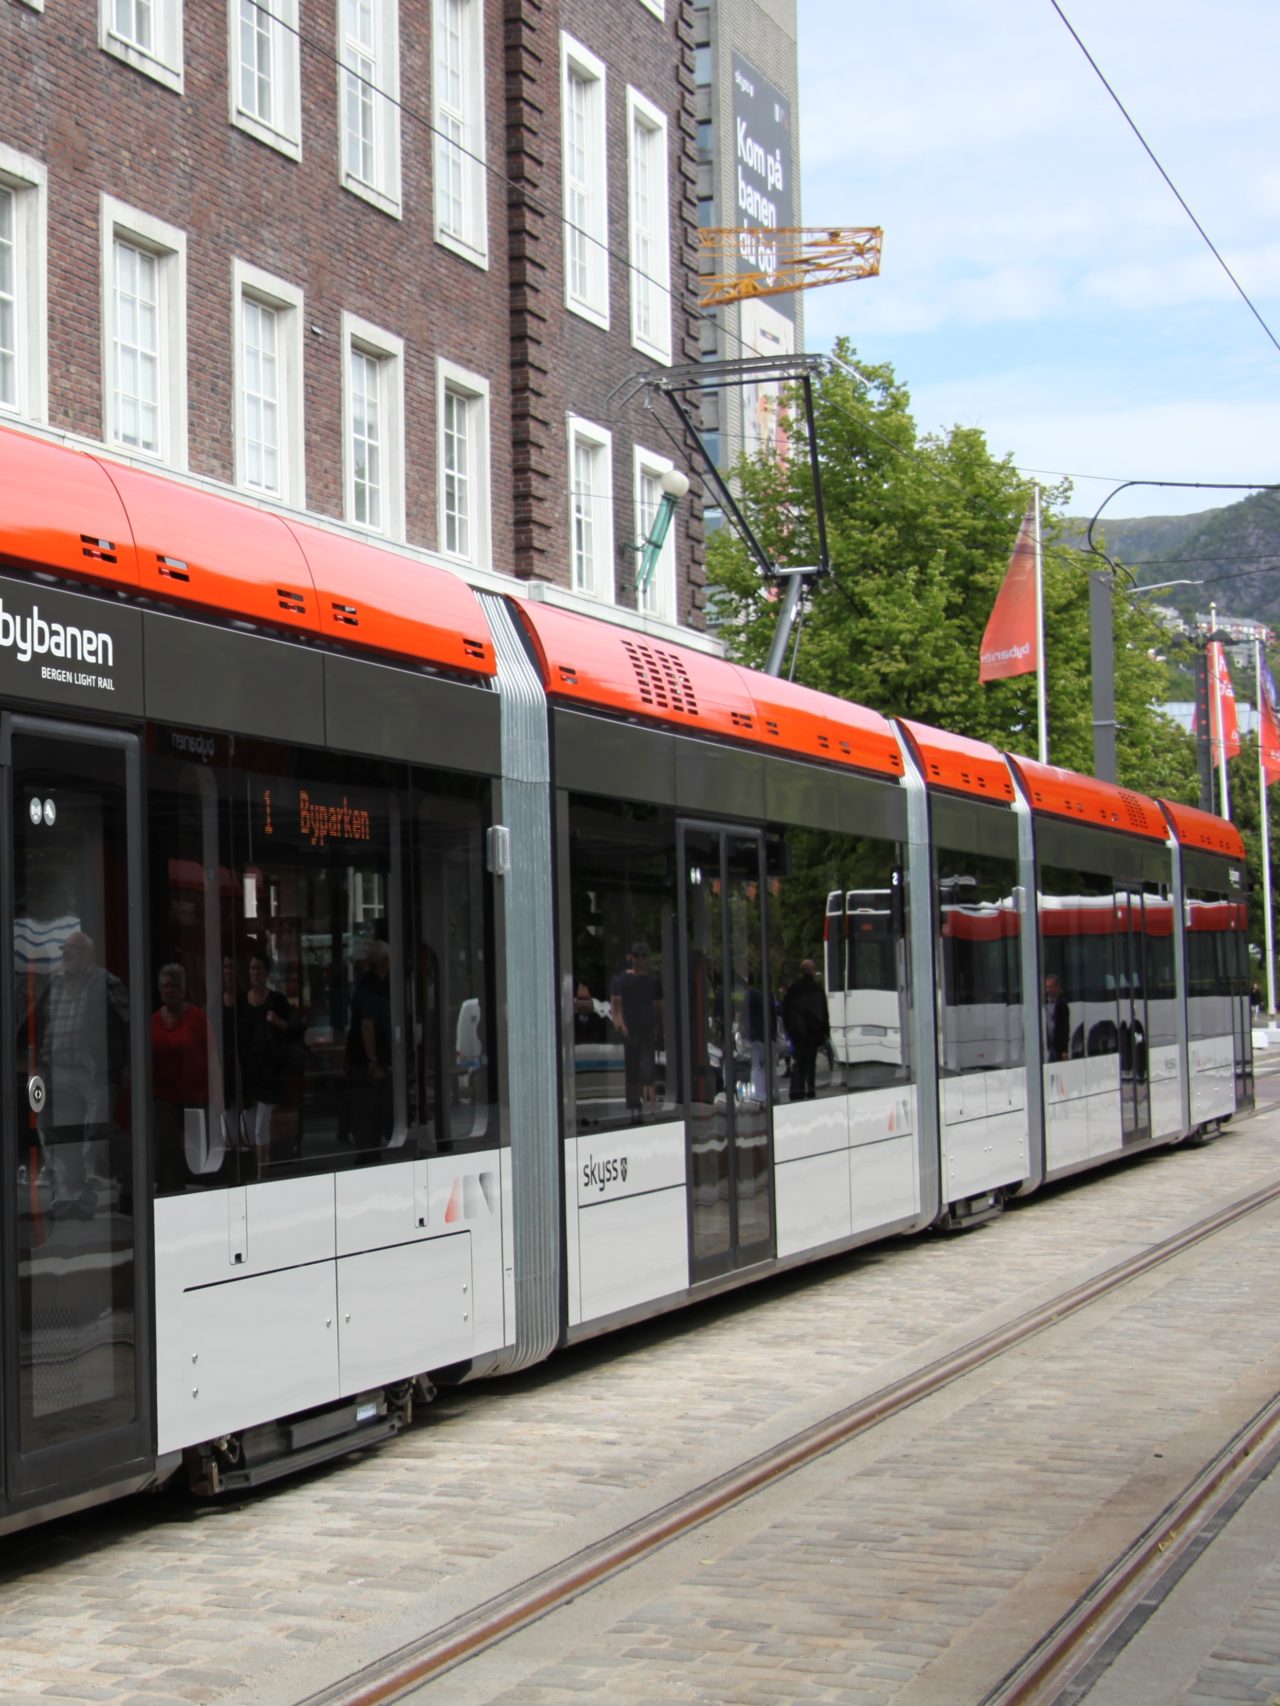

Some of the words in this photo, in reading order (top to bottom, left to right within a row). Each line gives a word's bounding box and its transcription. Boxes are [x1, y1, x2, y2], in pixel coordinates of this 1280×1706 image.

[736, 117, 766, 177] Kom
[767, 149, 783, 192] på
[738, 165, 777, 233] banen
[41, 666, 73, 684] BERGEN
[73, 673, 96, 687] LIGHT
[97, 677, 116, 691] RAIL
[263, 789, 273, 835] 1
[298, 789, 371, 846] Byparken
[582, 1153, 619, 1192] skyss
